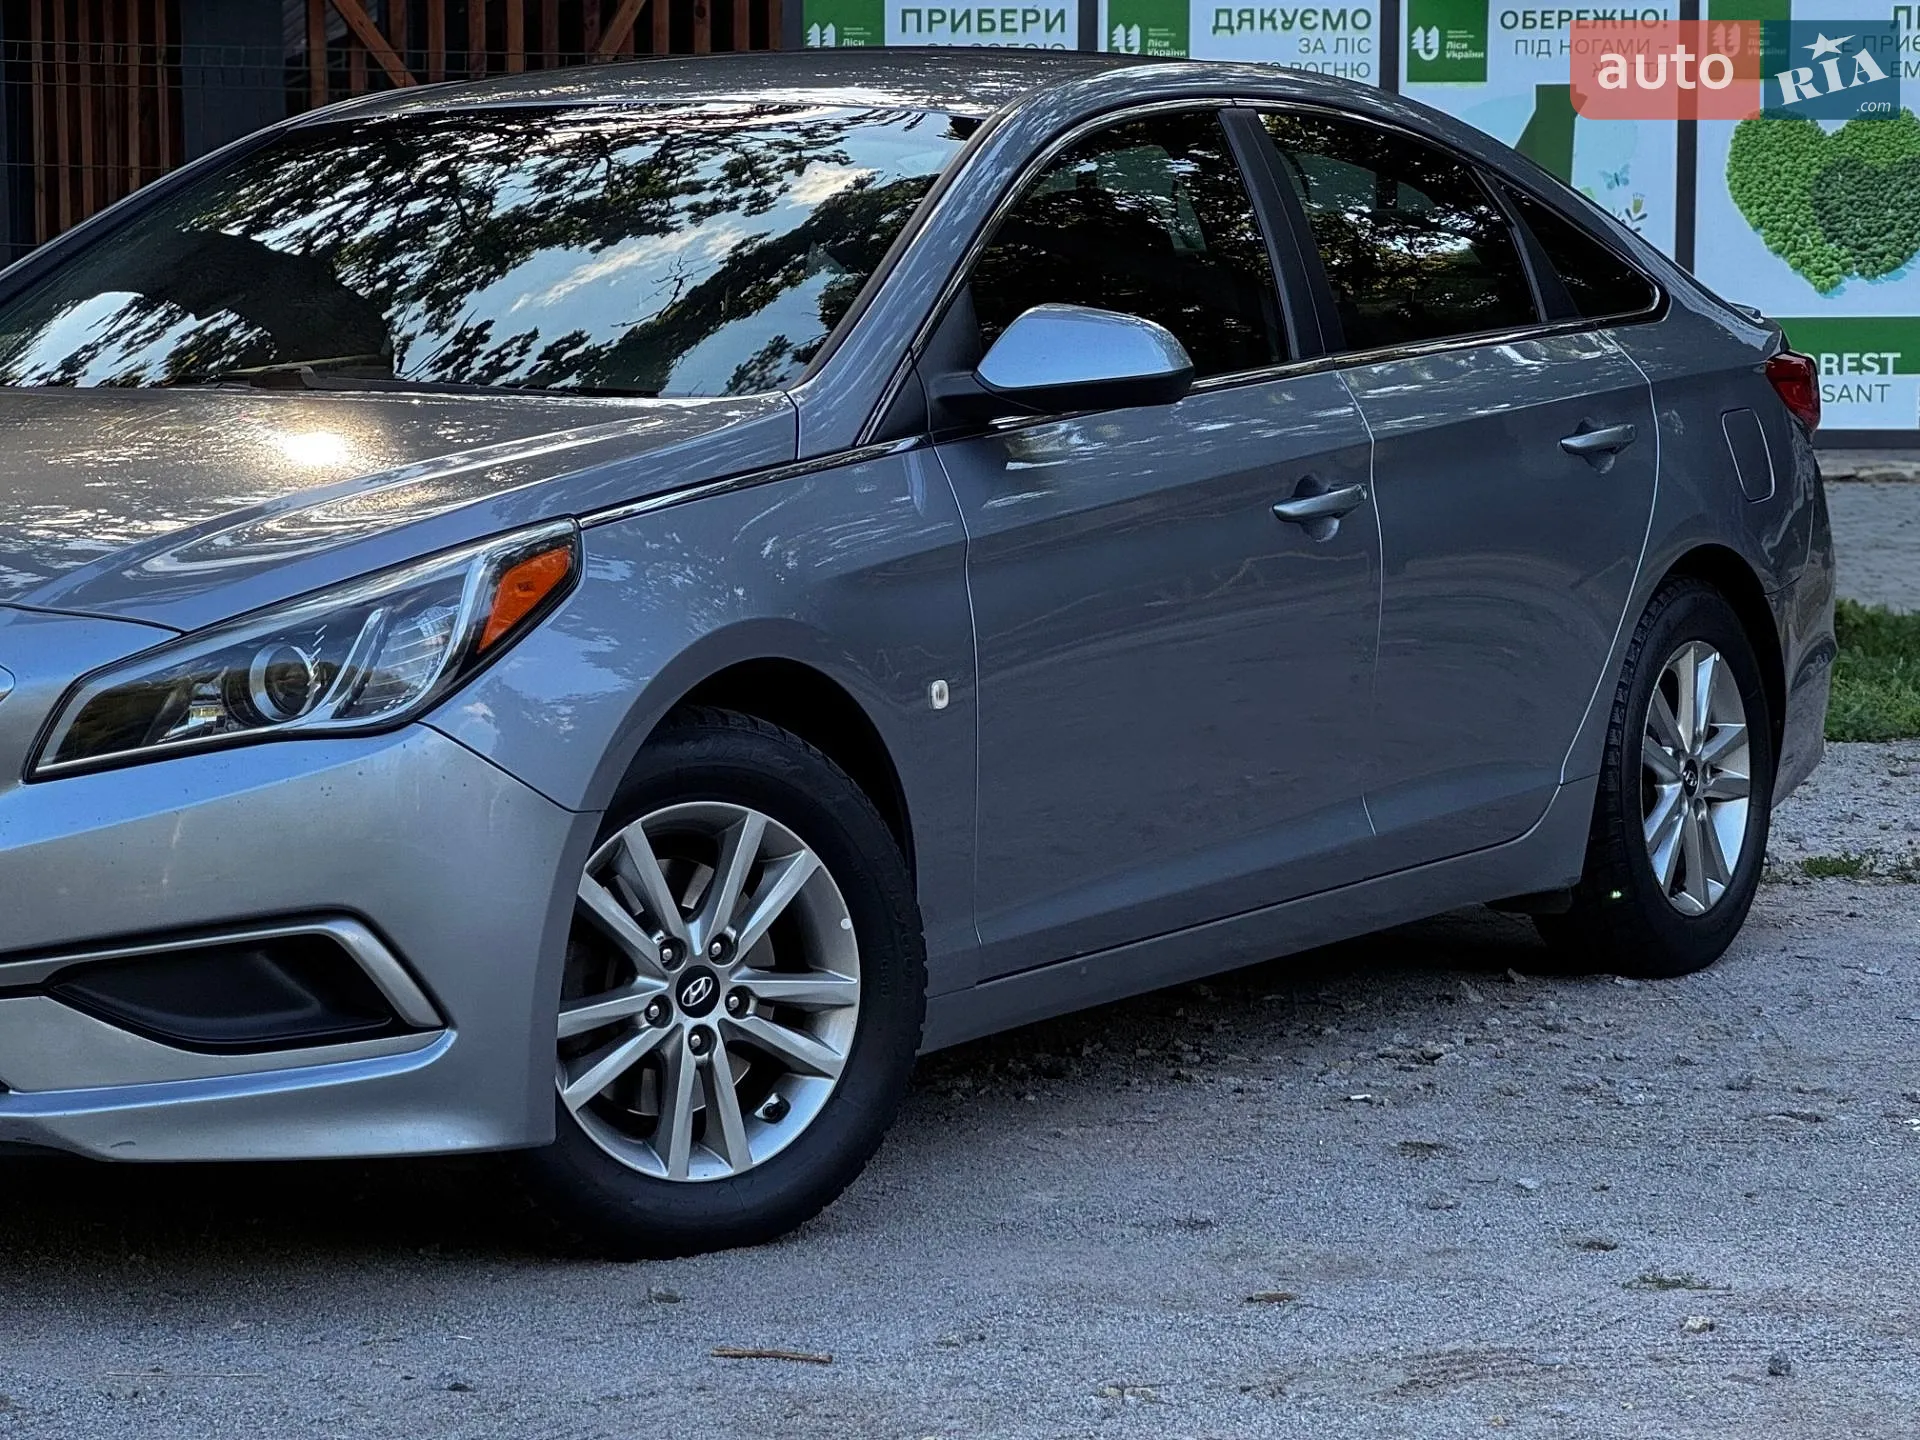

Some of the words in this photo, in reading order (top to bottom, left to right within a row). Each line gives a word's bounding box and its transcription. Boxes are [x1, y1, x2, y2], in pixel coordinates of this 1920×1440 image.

[901, 8, 1066, 33] ПРИБЕРИ
[1212, 8, 1372, 35] ДЯКУЄМО
[1500, 9, 1668, 29] ОБЕРЕЖНО!
[1298, 37, 1326, 54] ЗА
[1334, 37, 1372, 54] ЛІС
[1515, 39, 1551, 58] ПІД
[1560, 39, 1651, 55] НОГАМИ
[1820, 352, 1902, 376] REST
[1821, 384, 1891, 403] SANT
